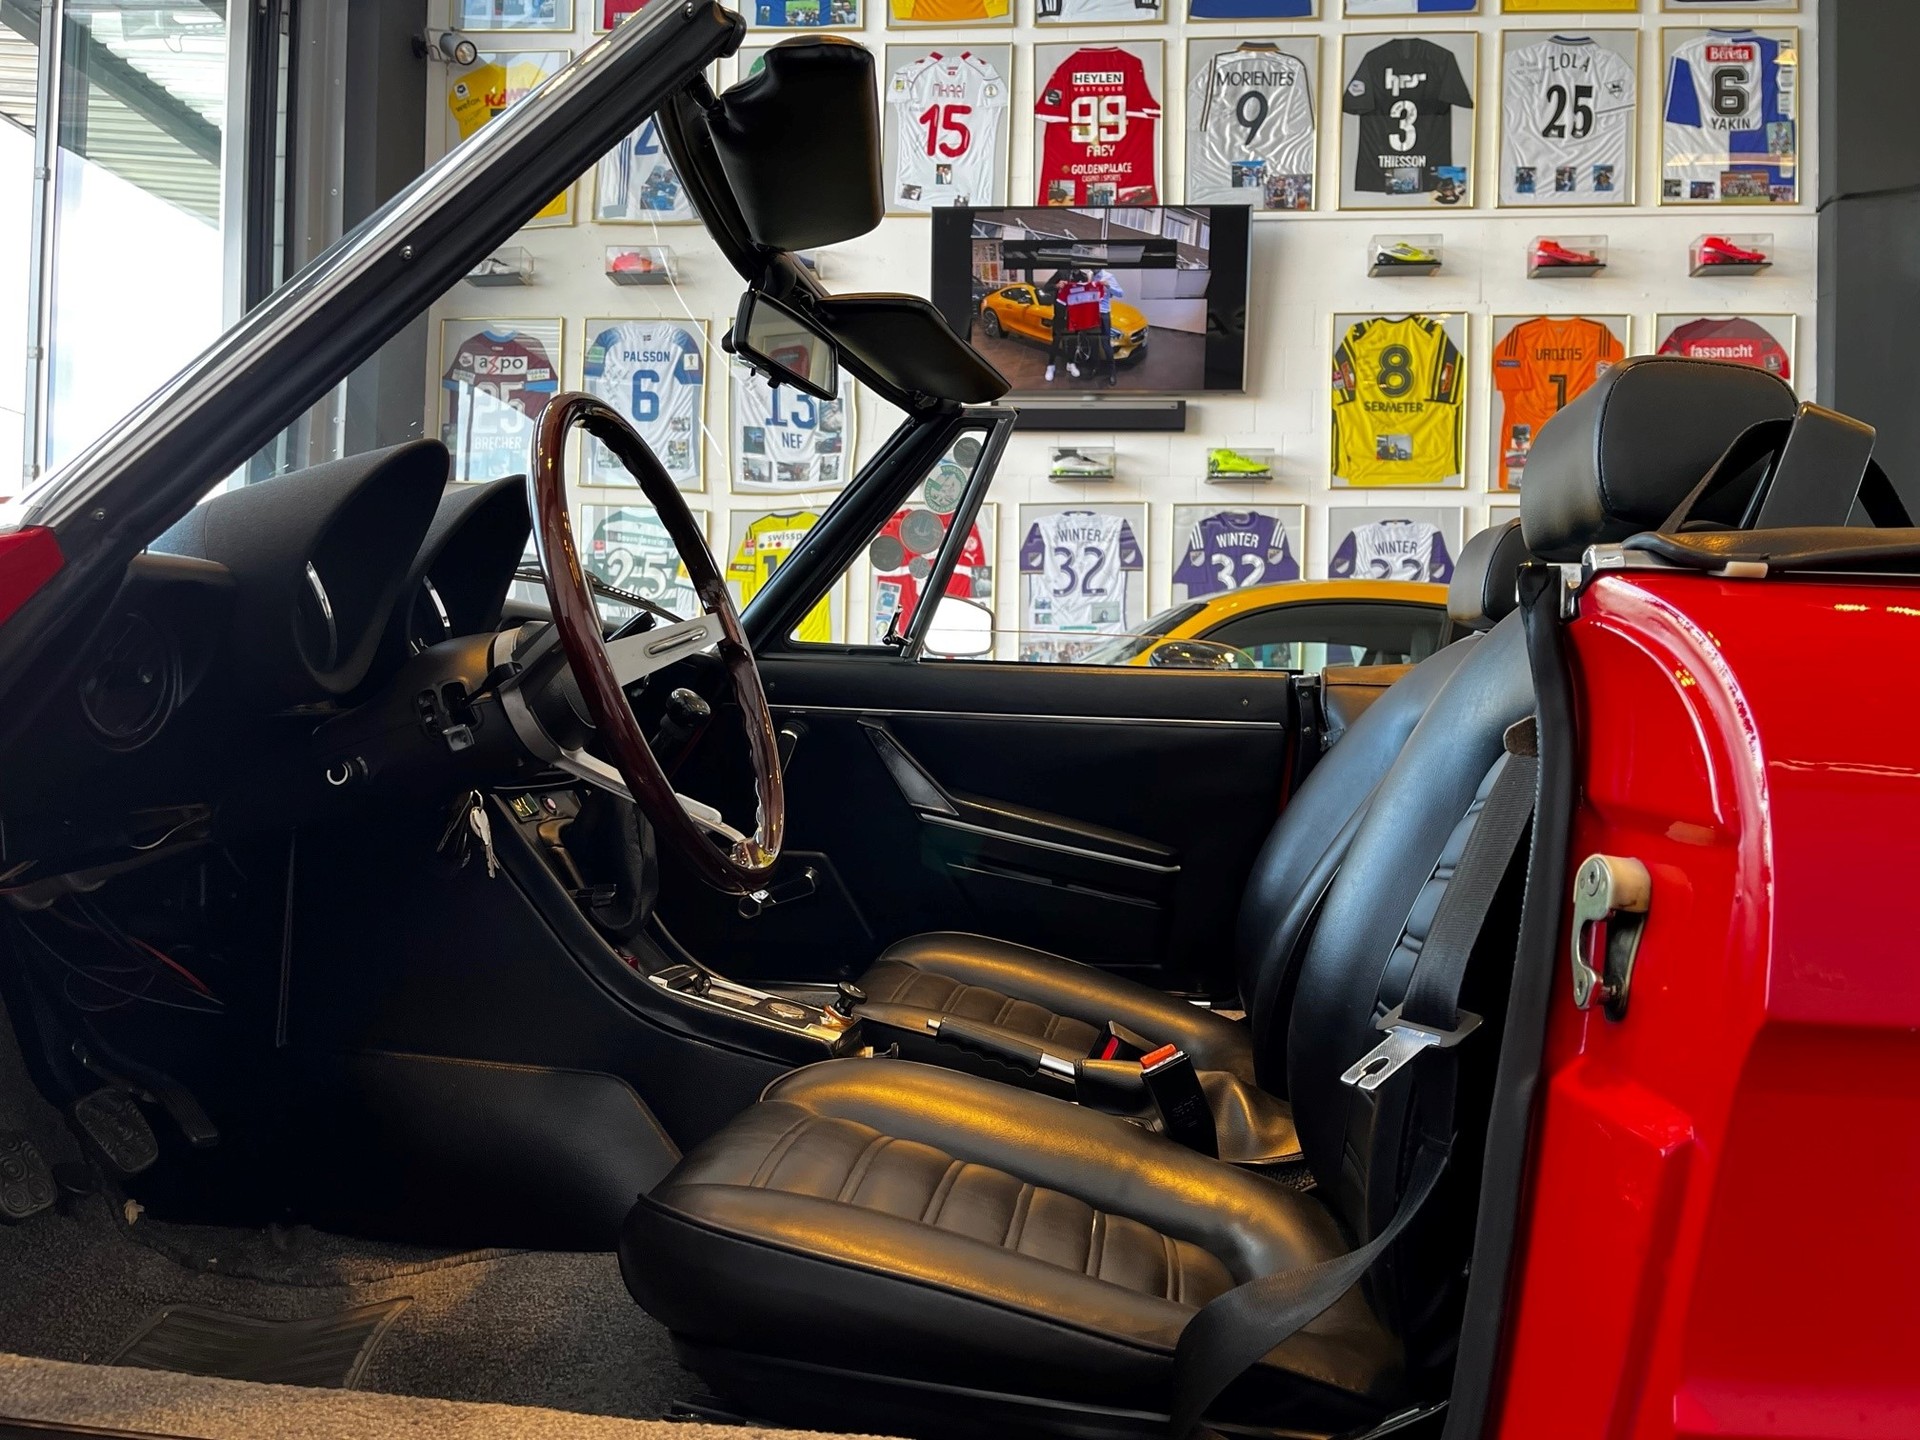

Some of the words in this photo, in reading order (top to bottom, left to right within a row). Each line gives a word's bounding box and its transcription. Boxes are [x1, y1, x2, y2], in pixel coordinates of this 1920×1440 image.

[1548, 53, 1591, 72] ZOLA
[1074, 73, 1122, 83] HEYLEN
[1217, 72, 1295, 87] MORIENTES
[1711, 65, 1749, 117] 6
[1071, 95, 1127, 143] 99
[1236, 90, 1269, 146] 9
[1542, 84, 1593, 139] 25
[919, 103, 972, 158] 15
[1388, 100, 1418, 152] 3
[1711, 118, 1751, 130] YAKIN
[1086, 145, 1116, 158] FREY
[1071, 162, 1133, 175] GOLDENPALACE
[1378, 155, 1427, 168] THIESSON
[623, 351, 671, 362] PALSSON
[1690, 344, 1754, 358] fassnacht
[1377, 344, 1415, 399] 8
[631, 369, 660, 422] 6
[765, 385, 818, 430] 13
[1364, 401, 1424, 413] SERMETER
[474, 436, 522, 450] BRECHER
[781, 432, 803, 449] NEF
[1057, 528, 1102, 543] WINTER
[1216, 532, 1259, 549] WINTER
[1374, 541, 1418, 555] WINTER
[607, 547, 668, 601] 25
[1052, 546, 1107, 597] 32
